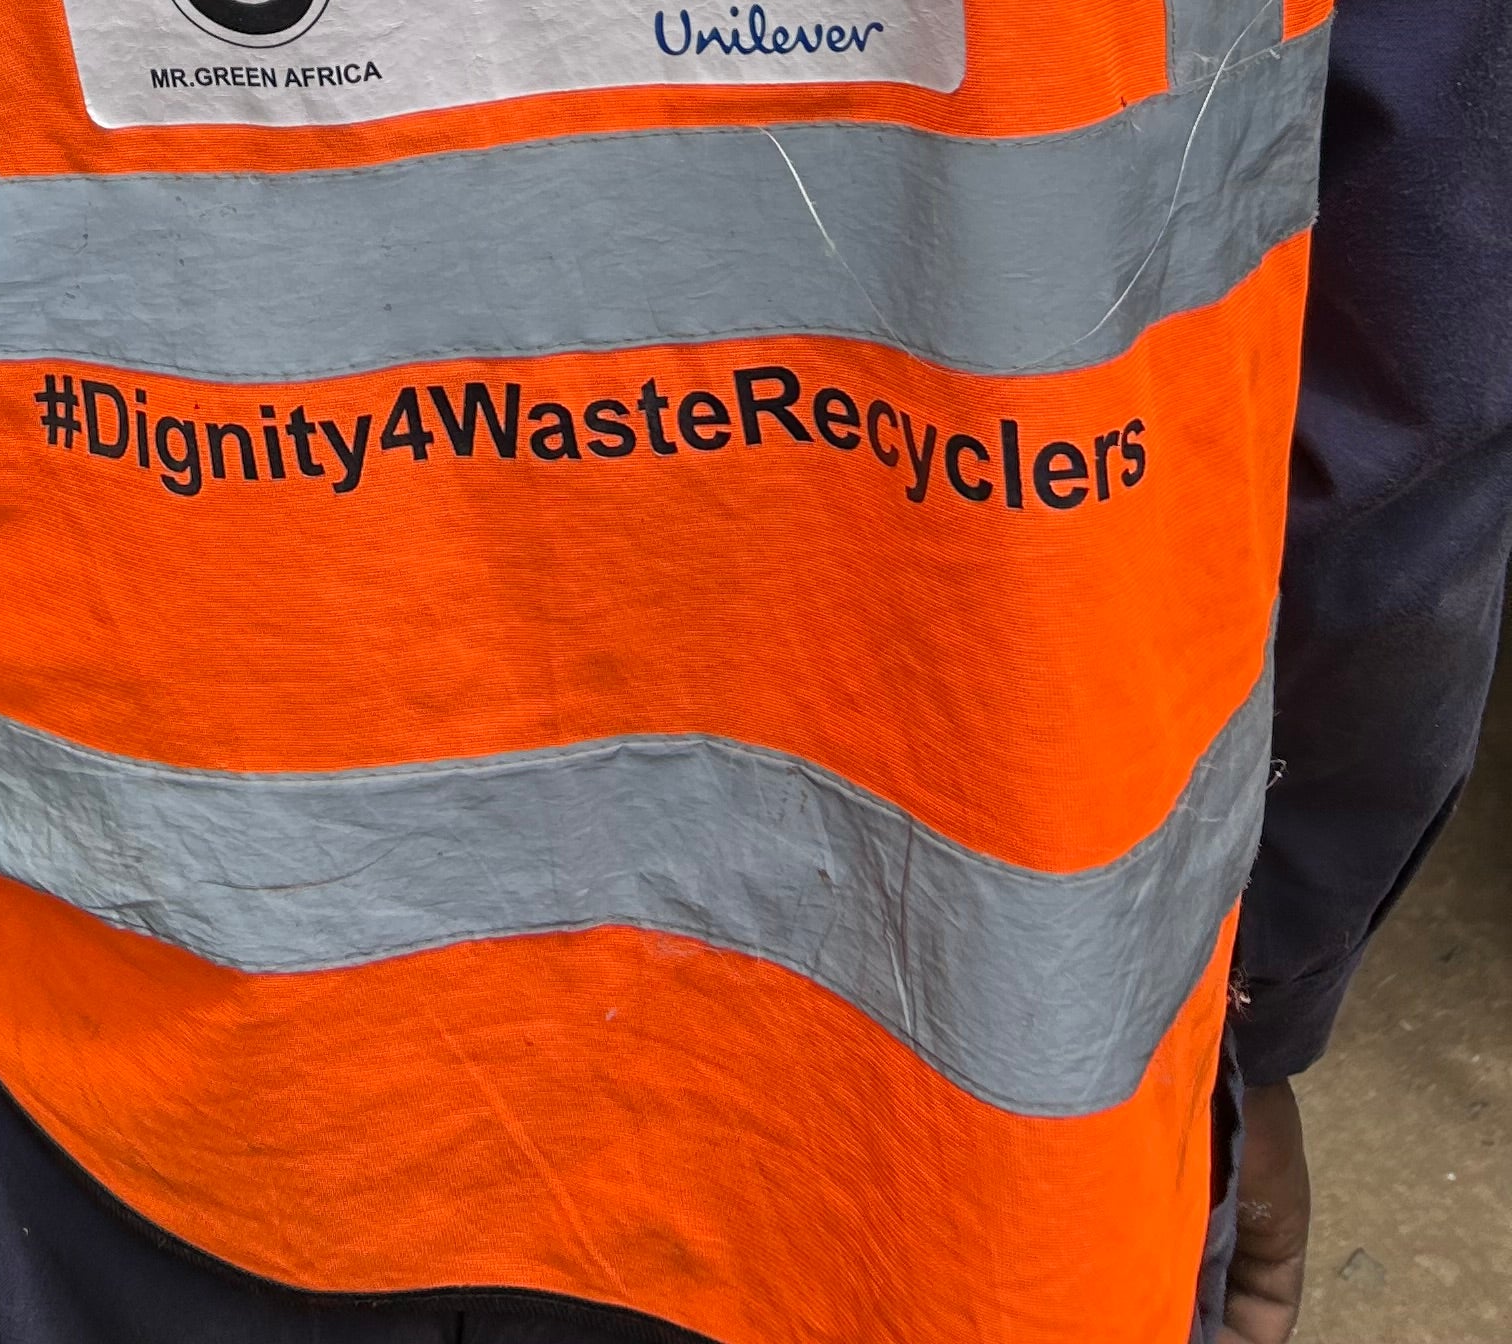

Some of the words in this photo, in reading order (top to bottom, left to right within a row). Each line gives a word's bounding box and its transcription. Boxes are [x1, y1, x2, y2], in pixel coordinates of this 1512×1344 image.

[654, 3, 885, 57] Unilever
[284, 61, 383, 88] AFRICA
[33, 364, 1147, 511] #Dignity4WasteRecyclers
